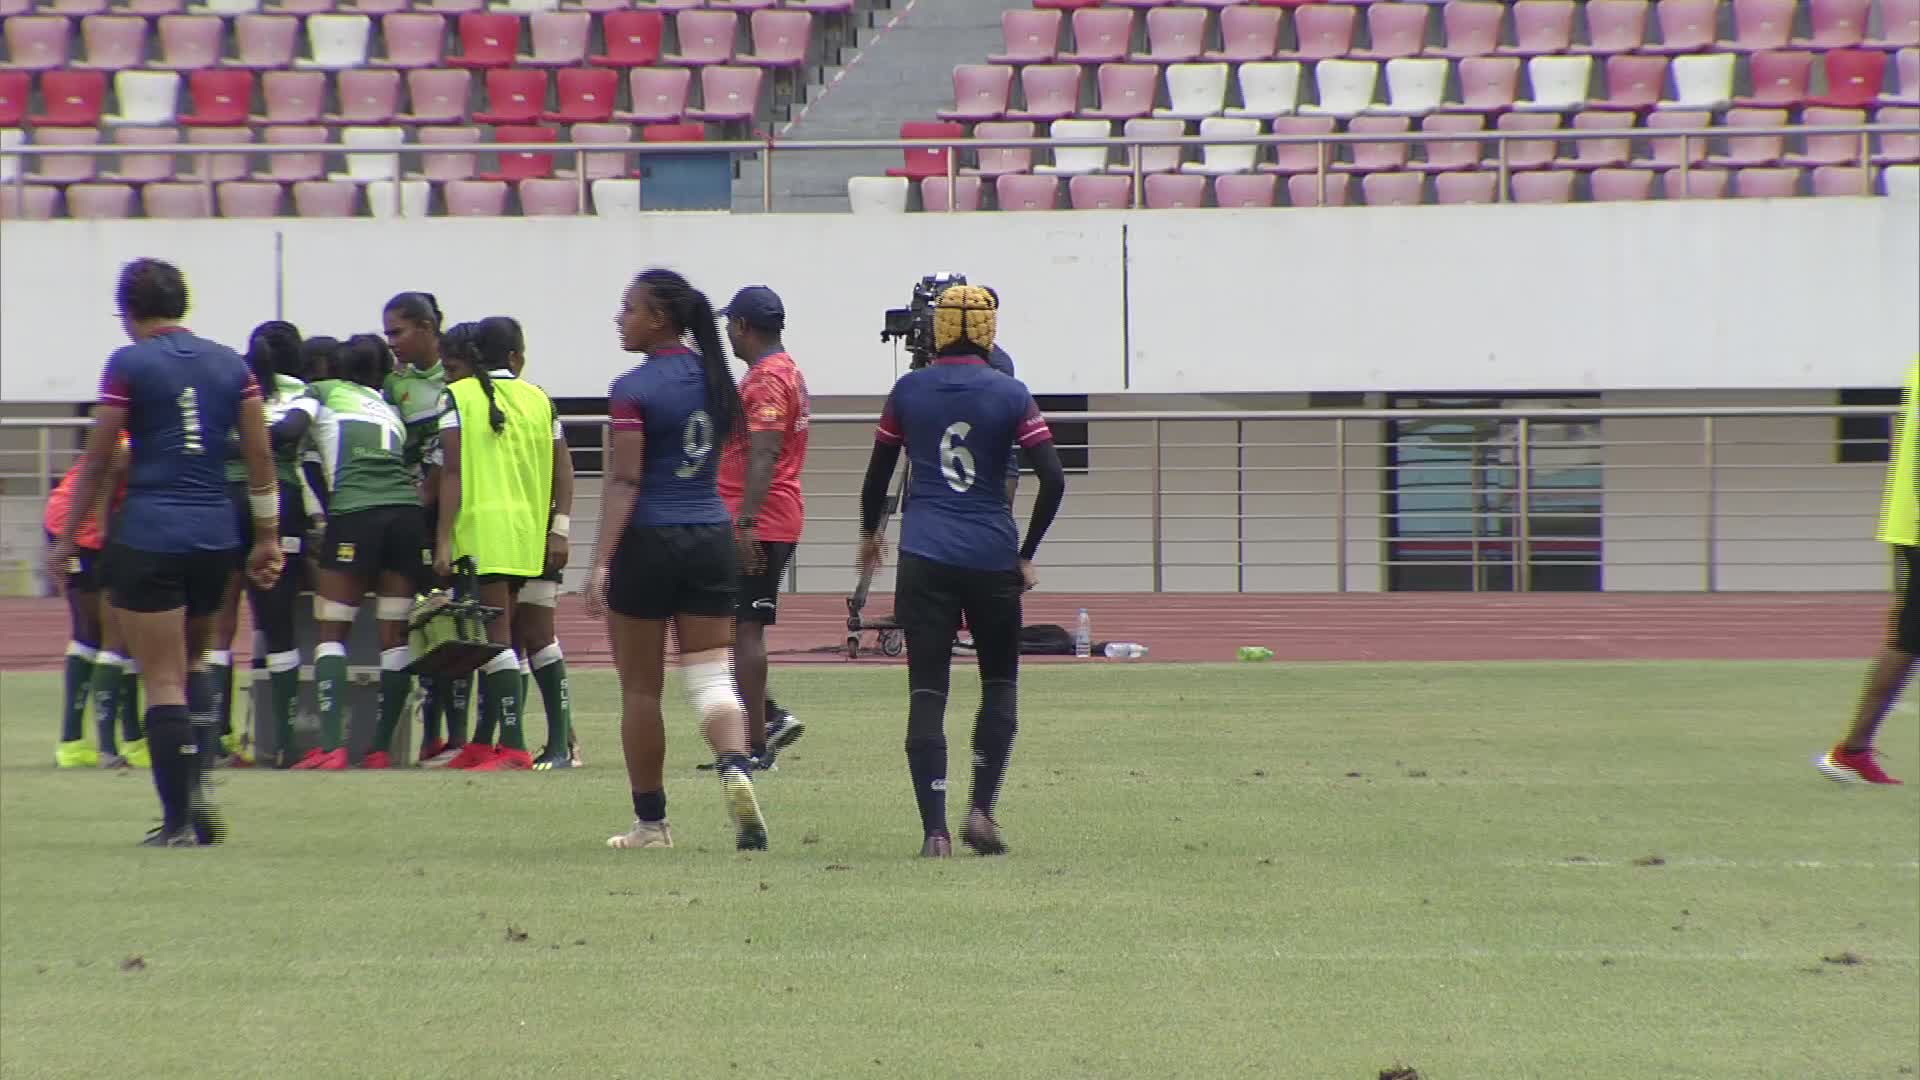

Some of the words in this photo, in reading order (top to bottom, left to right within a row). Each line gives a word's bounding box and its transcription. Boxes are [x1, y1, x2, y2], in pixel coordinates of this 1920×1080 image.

[177, 387, 206, 455] 1
[673, 410, 713, 478] 9
[940, 421, 976, 493] 6
[502, 696, 517, 726] SLR
